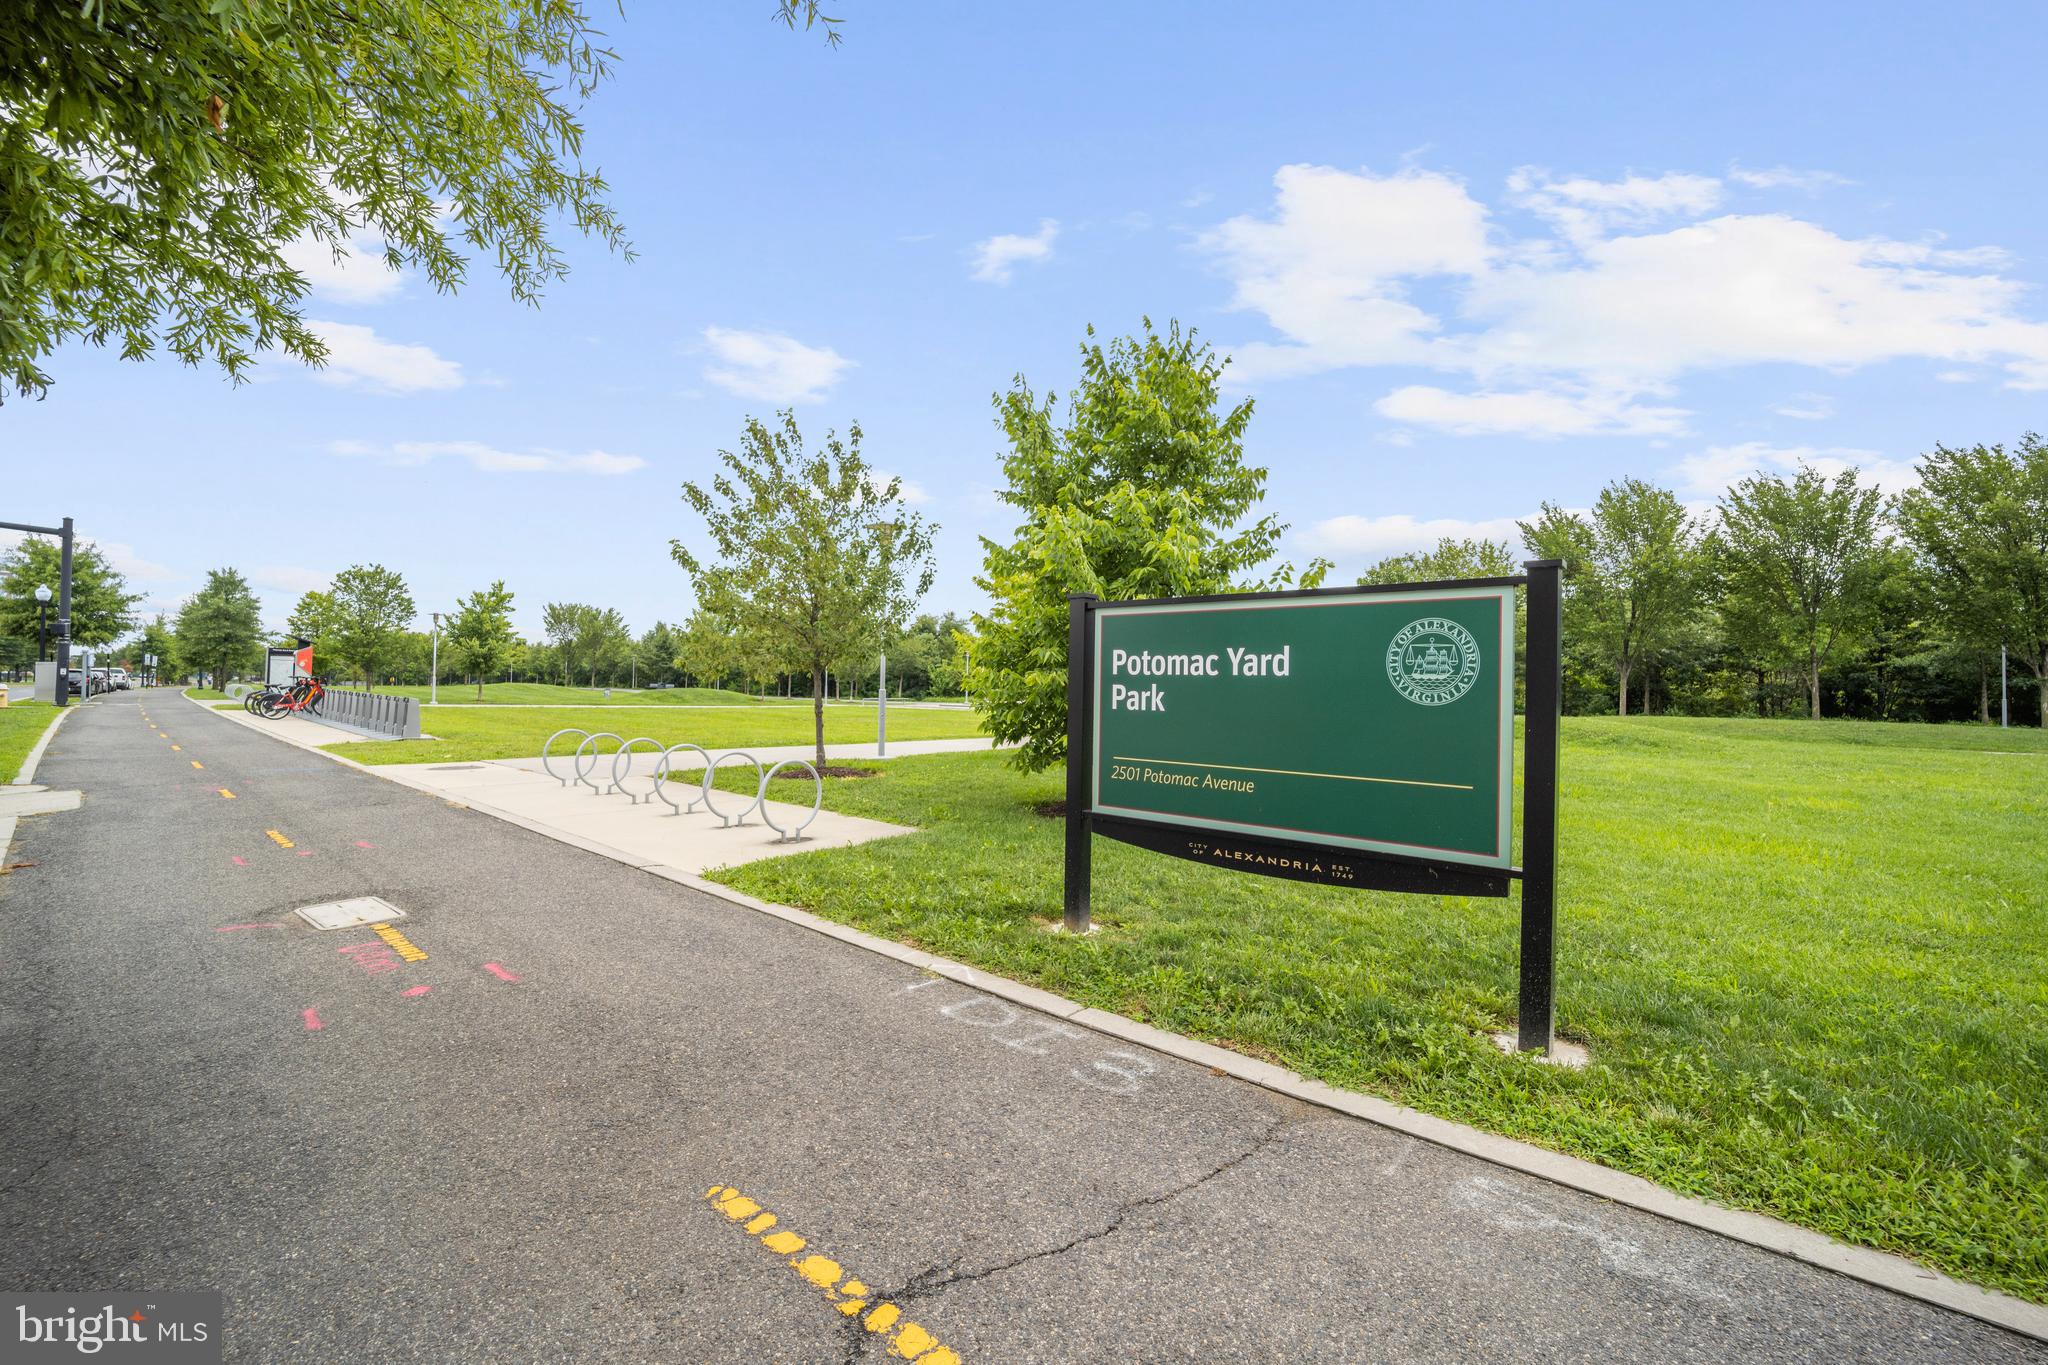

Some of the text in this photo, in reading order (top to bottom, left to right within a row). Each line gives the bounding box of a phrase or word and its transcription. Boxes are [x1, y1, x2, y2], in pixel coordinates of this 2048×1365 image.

[1112, 645, 1290, 676] Potomac Yard
[1389, 620, 1476, 677] CITY OF ALEXANDRIA
[1111, 683, 1165, 712] Park
[1398, 679, 1469, 703] VIRGINIA
[1111, 765, 1255, 793] 2501 Potomac Avenue
[1188, 842, 1208, 850] CITY
[1213, 848, 1322, 873] ALEXANDRIA
[1331, 871, 1354, 880] 1749
